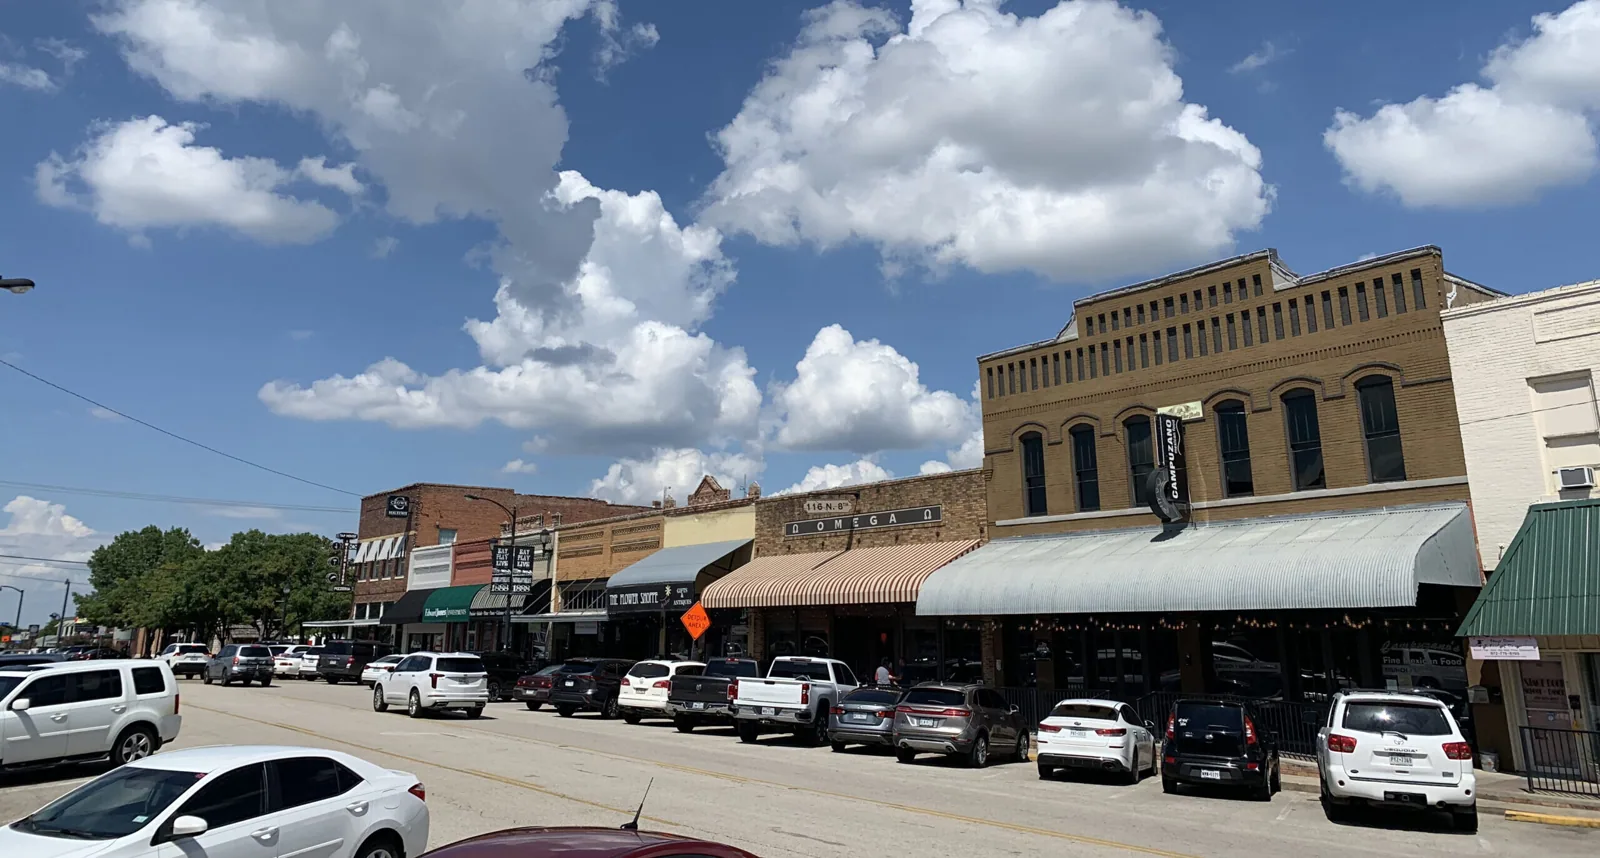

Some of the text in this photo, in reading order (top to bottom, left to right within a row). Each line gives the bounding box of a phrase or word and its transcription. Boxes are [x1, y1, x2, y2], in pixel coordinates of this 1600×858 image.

[1165, 419, 1179, 499] CAMPUZANO
[816, 513, 897, 531] OMEGA
[609, 592, 659, 606] THE FLOWER SHOPPE
[687, 613, 707, 621] DETOUR
[1382, 656, 1462, 665] Fine Mexicn Food
